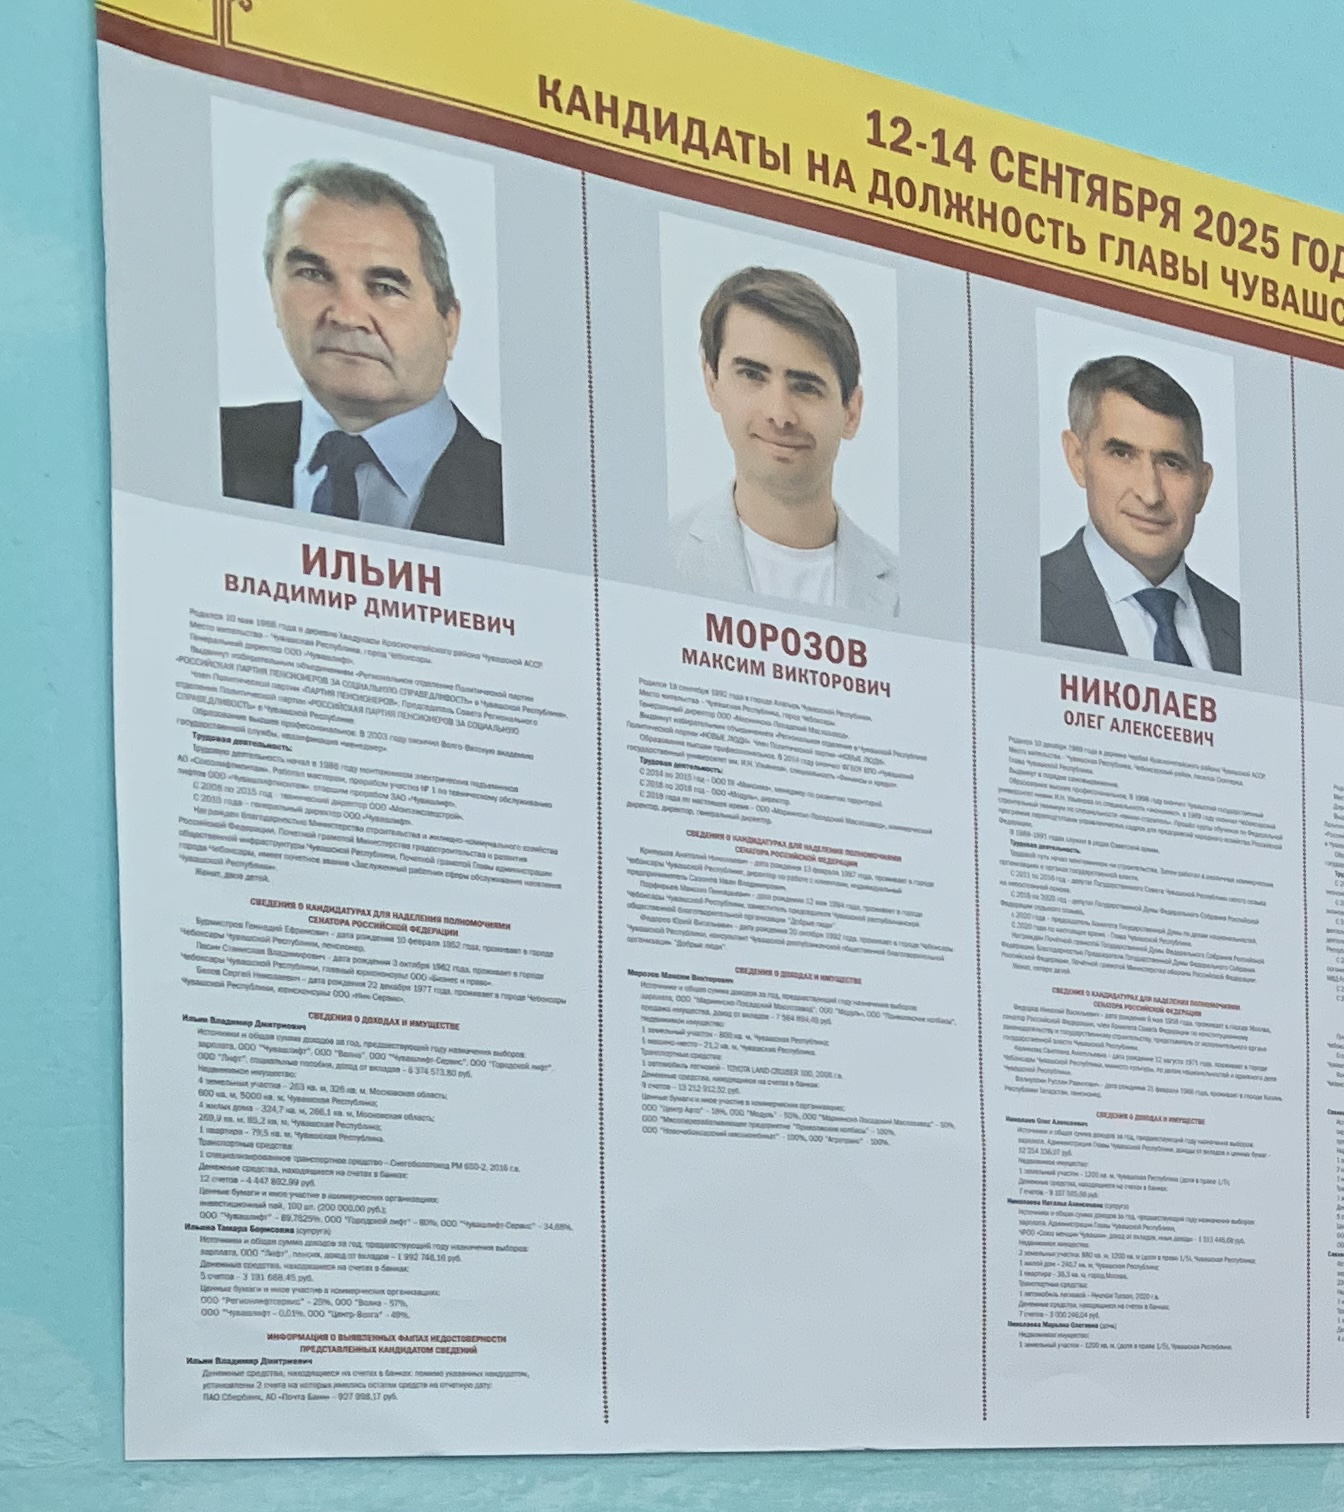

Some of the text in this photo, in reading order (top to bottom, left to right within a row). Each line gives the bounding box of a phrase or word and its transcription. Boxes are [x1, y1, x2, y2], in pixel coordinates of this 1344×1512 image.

[539, 75, 790, 175] КАНДИДАТЫ
[808, 149, 856, 193] НА
[869, 169, 1085, 255] ДОЛЖНОСТЬ
[1100, 233, 1207, 289] ГЛАВЫ
[867, 110, 976, 173] 12-14
[991, 146, 1180, 232] СЕНТЯБРЯ
[1194, 205, 1279, 258] 2025
[301, 543, 442, 597] ИЛЬИН
[224, 573, 516, 636] ВЛАДИМИР ДМИТРИЕВИЧ
[706, 612, 868, 668] МОРОЗОВ
[682, 647, 891, 698] МАКСИМ ВИКТОРОВИЧ
[1060, 673, 1217, 723] НИКОЛАЕВ
[1064, 710, 1214, 747] ОЛЕГ АЛЕКСЕЕВИЧ
